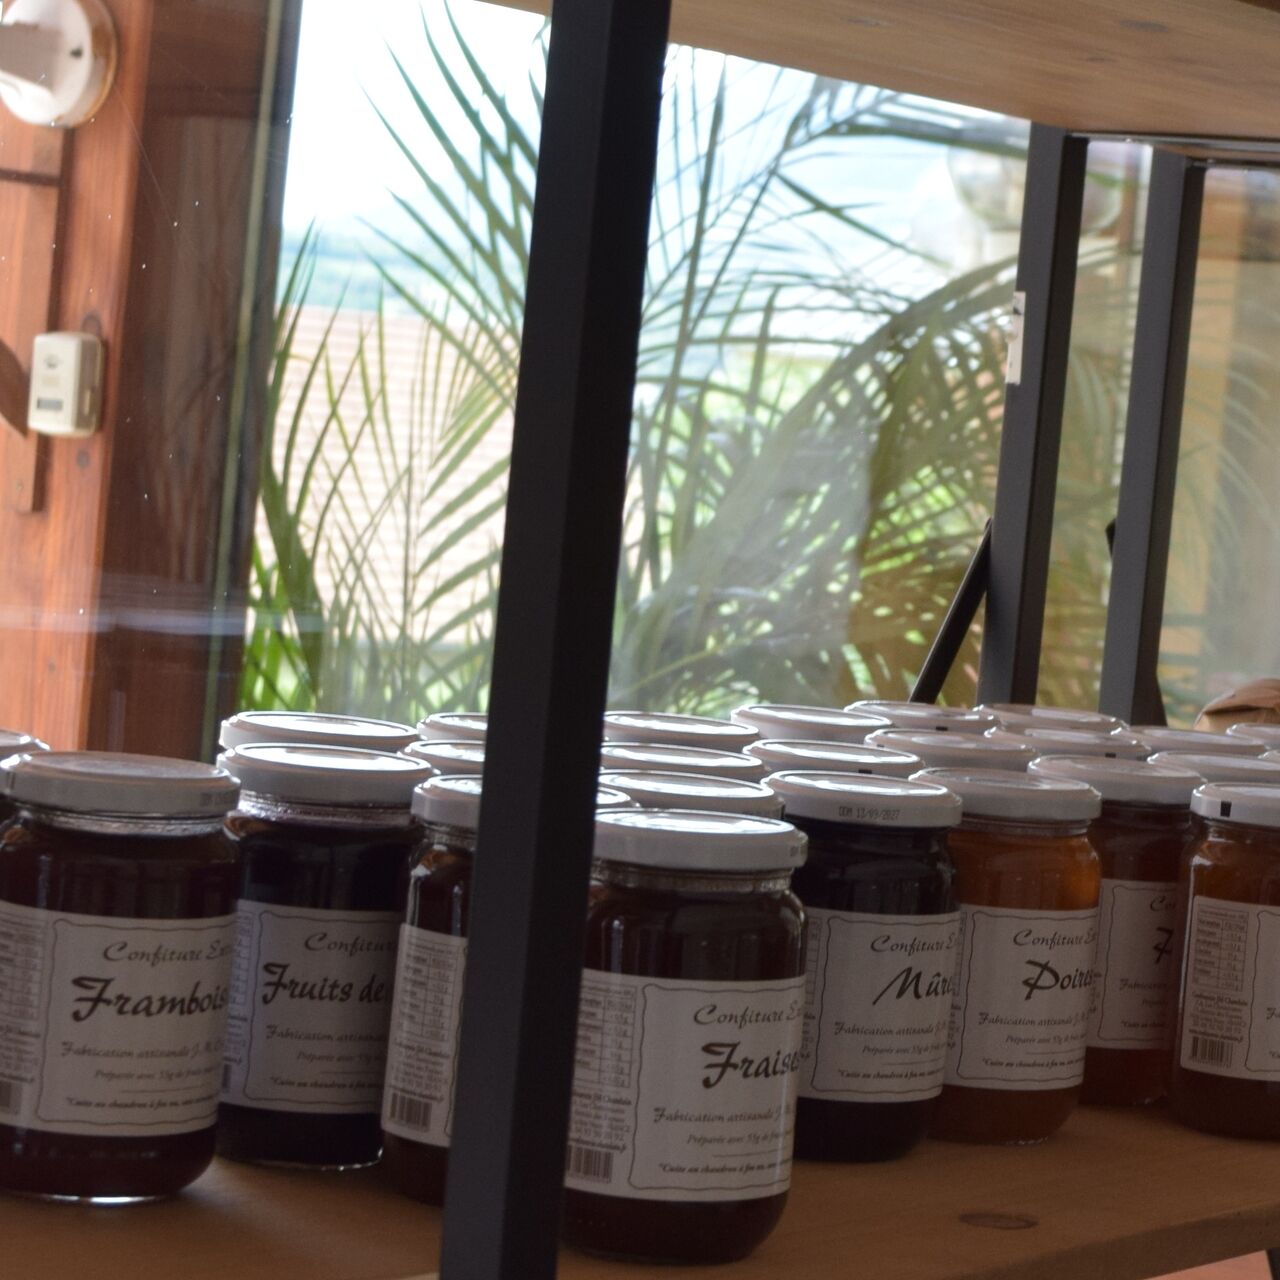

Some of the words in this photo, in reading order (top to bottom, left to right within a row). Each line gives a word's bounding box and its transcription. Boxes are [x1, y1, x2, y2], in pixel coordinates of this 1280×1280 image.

[102, 940, 202, 967] Confiture
[261, 961, 353, 1007] Fruits
[692, 1002, 784, 1030] Confiture
